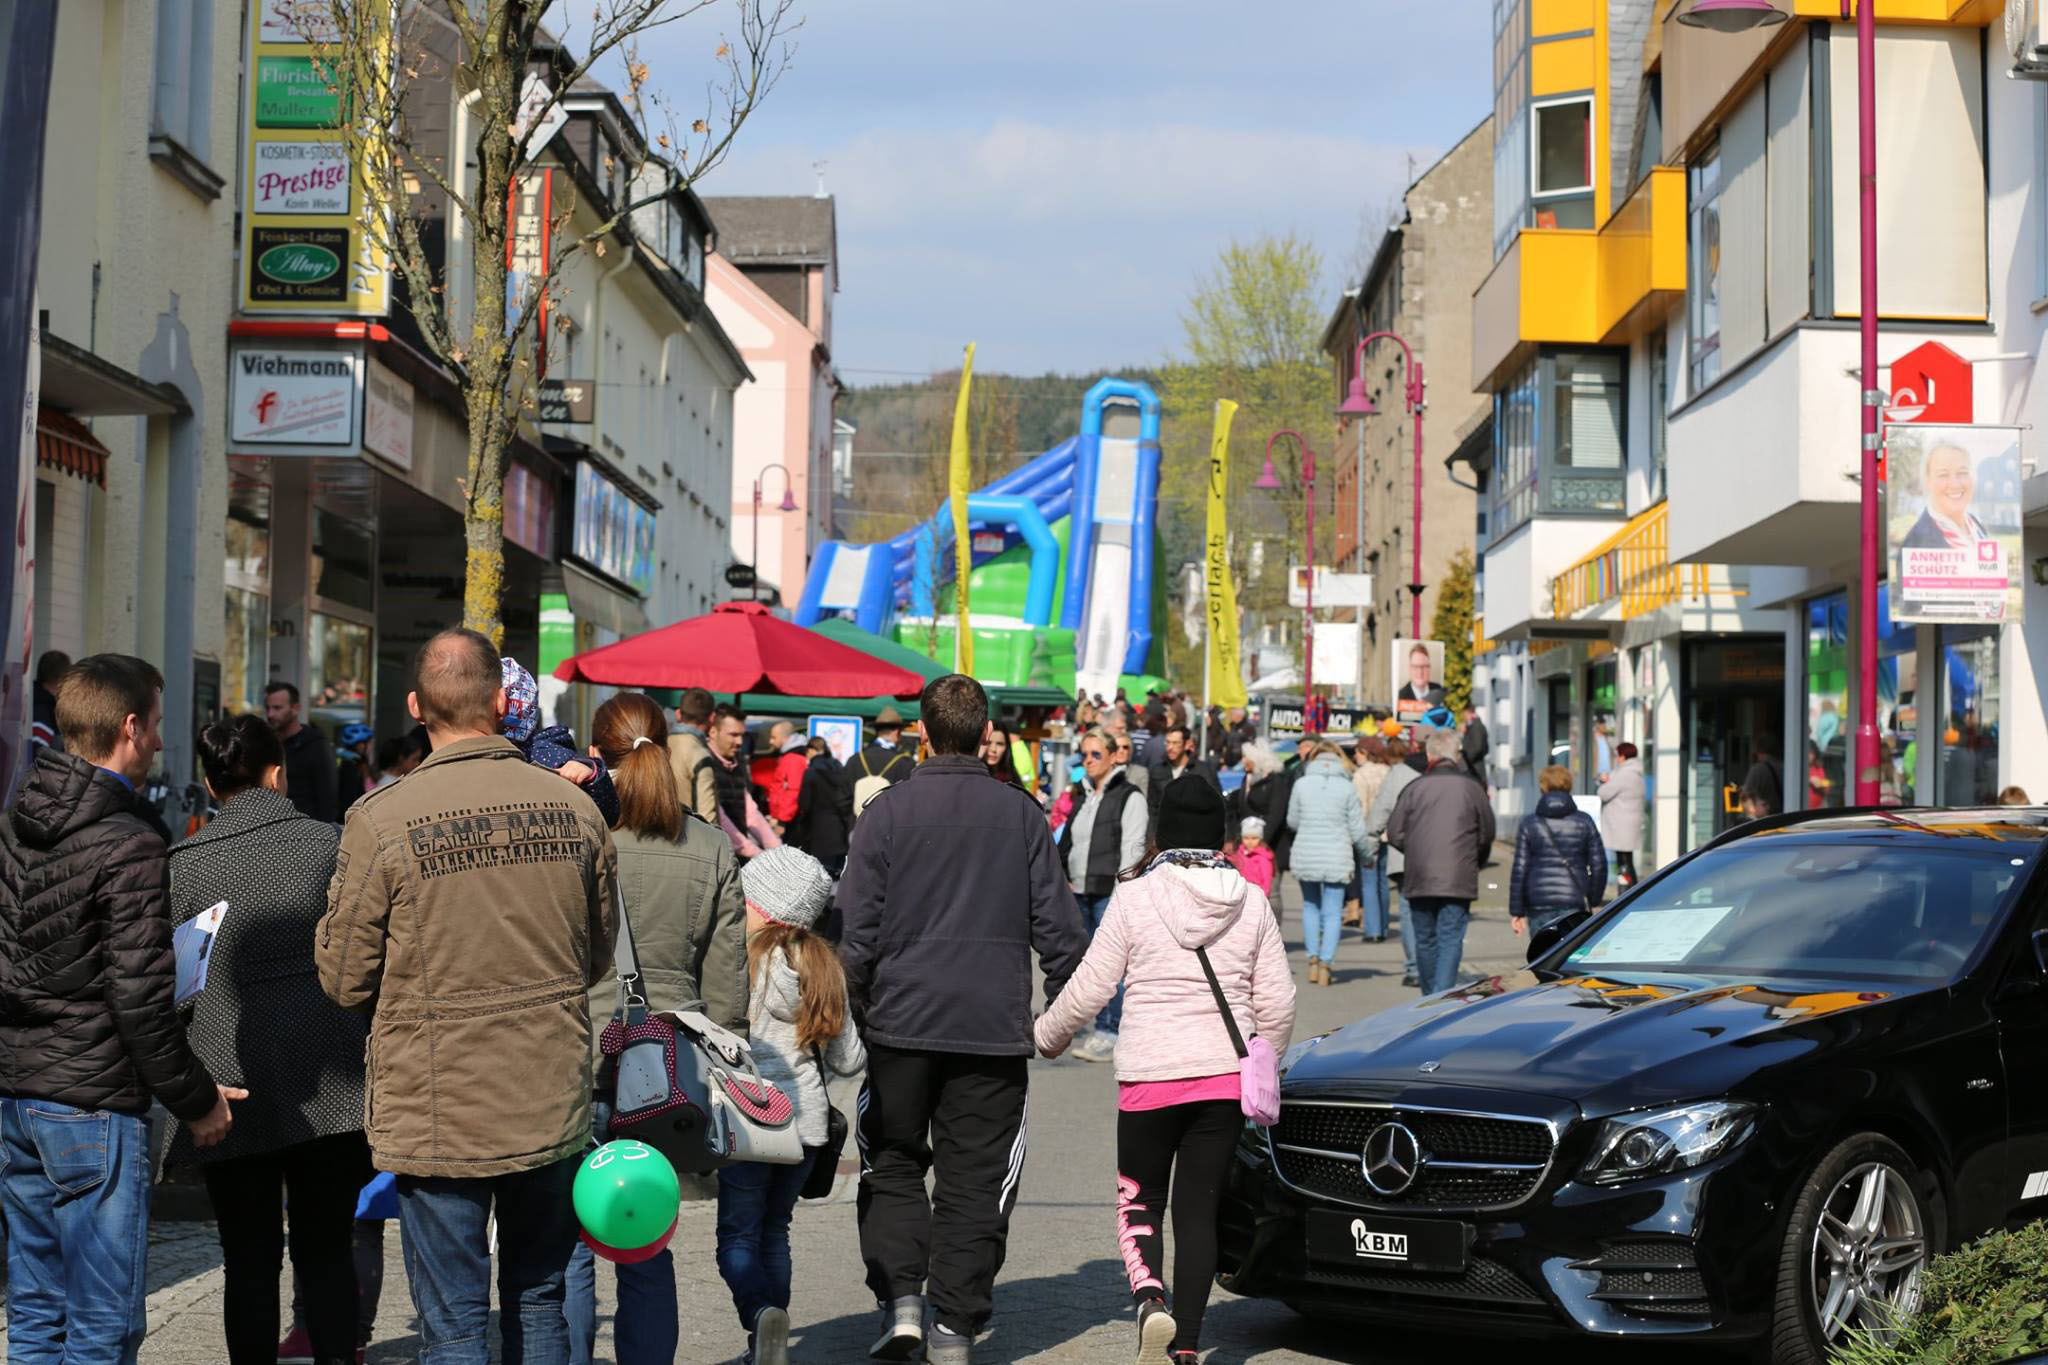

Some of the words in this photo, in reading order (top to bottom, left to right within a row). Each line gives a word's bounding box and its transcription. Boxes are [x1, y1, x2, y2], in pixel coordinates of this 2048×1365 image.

[258, 160, 346, 201] Prestige
[241, 355, 350, 376] Viehmann
[1910, 551, 1968, 562] ANNETTE
[1271, 708, 1302, 727] AUTO
[410, 815, 494, 858] CAMP
[507, 811, 582, 842] DAVID
